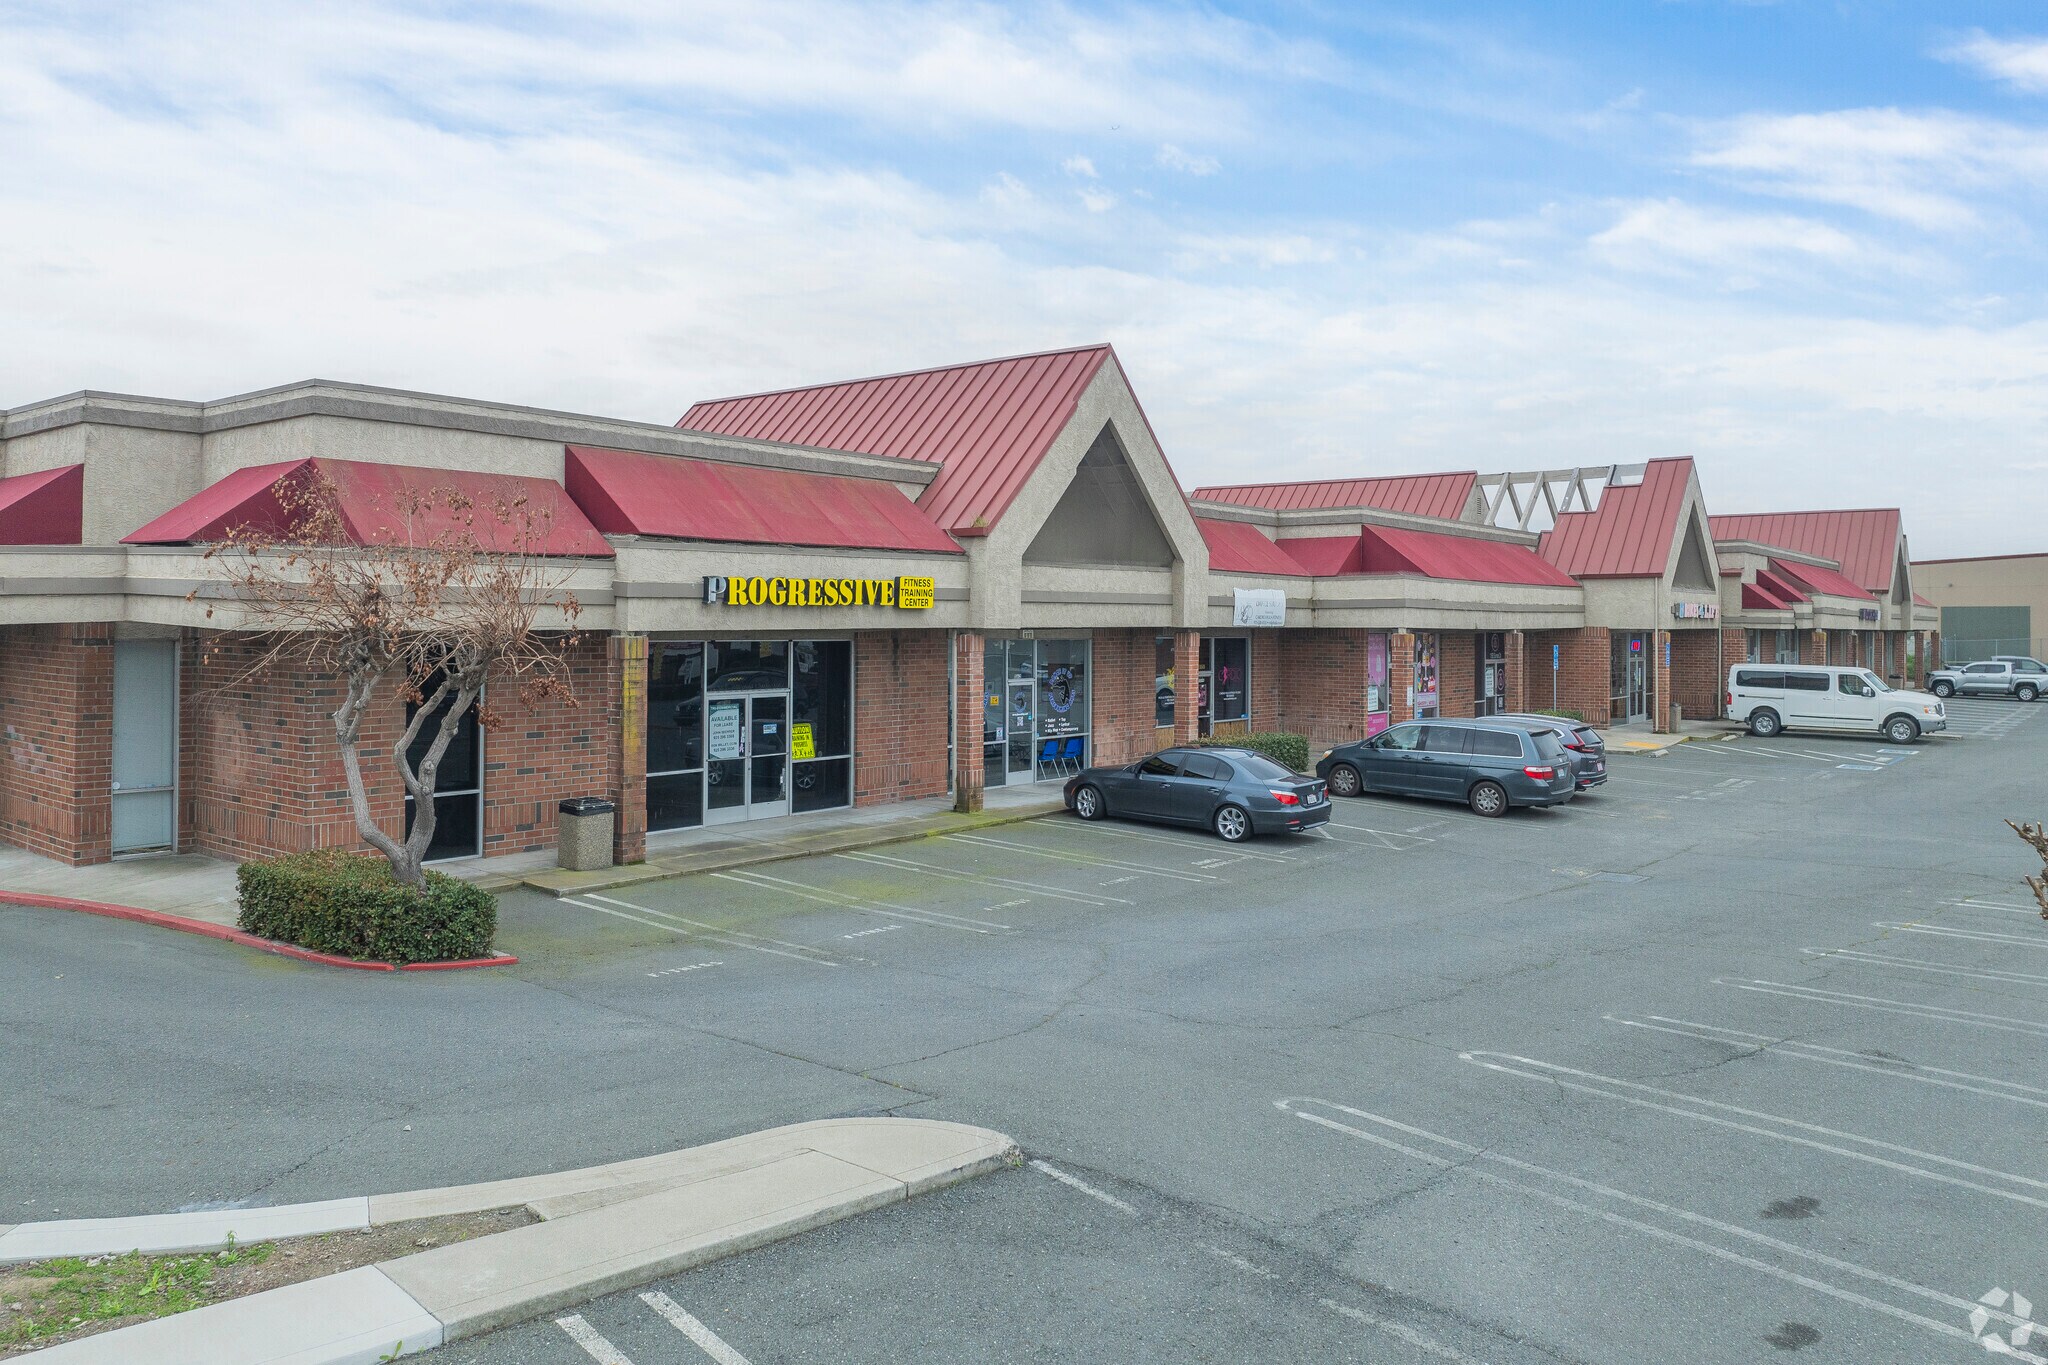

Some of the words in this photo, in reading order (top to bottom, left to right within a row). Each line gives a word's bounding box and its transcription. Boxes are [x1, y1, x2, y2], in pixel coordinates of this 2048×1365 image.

[904, 578, 931, 588] FITNESS
[703, 575, 895, 606] PROGRESSIVE
[900, 588, 933, 598] TRAINING
[904, 598, 929, 607] CENTER
[647, 961, 724, 977] FITNESS
